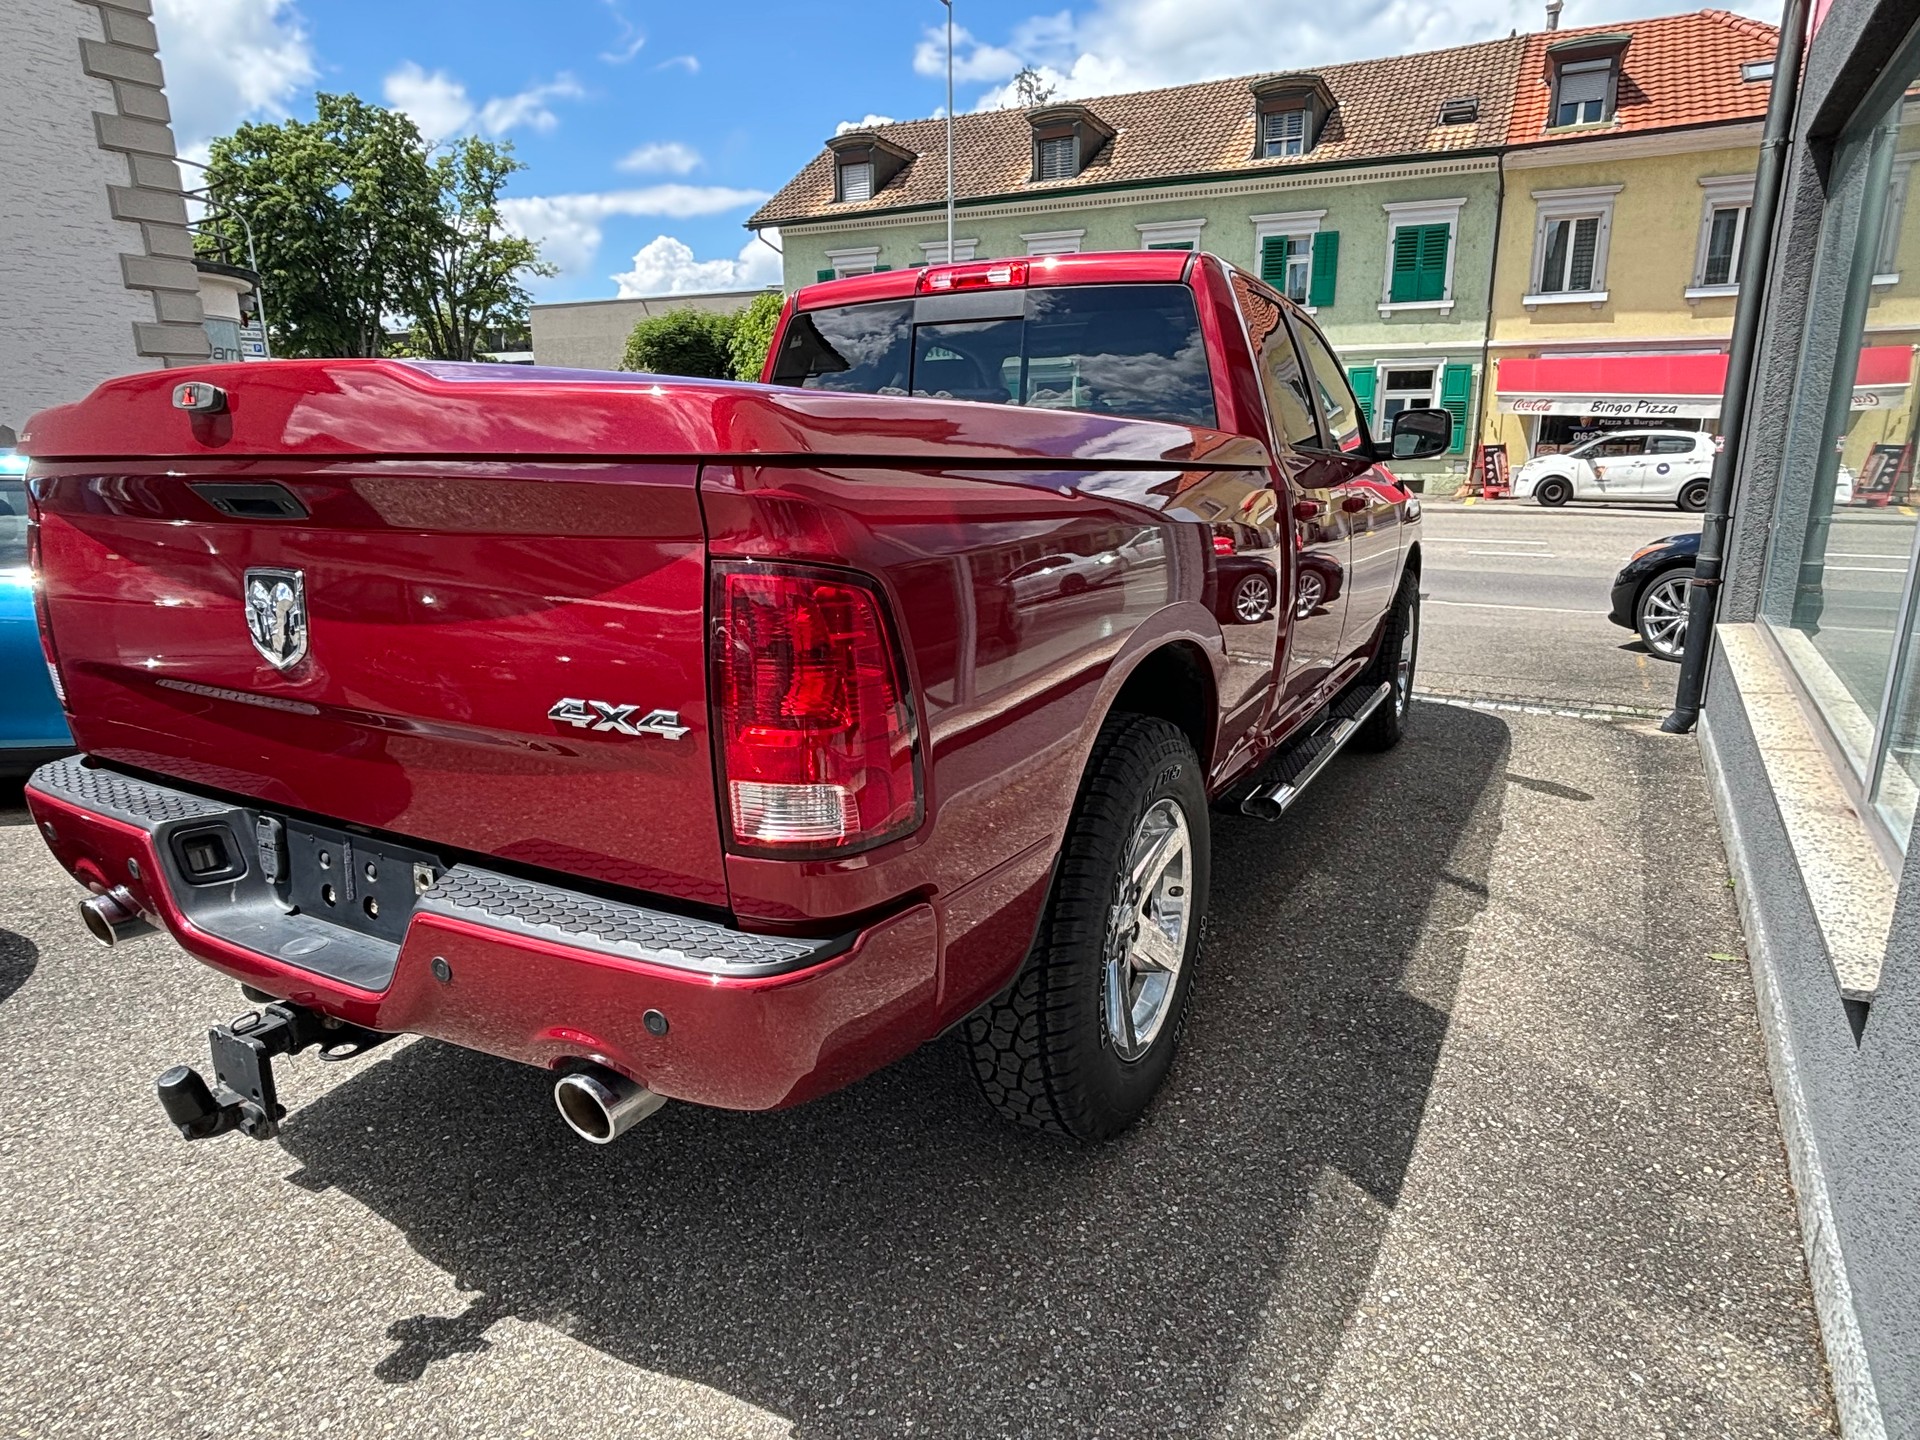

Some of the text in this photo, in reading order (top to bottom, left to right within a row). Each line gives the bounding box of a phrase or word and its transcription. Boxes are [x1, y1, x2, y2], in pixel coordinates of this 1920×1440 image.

[1590, 400, 1679, 416] Bingo Pizza
[1599, 418, 1664, 427] Pizza & Burger
